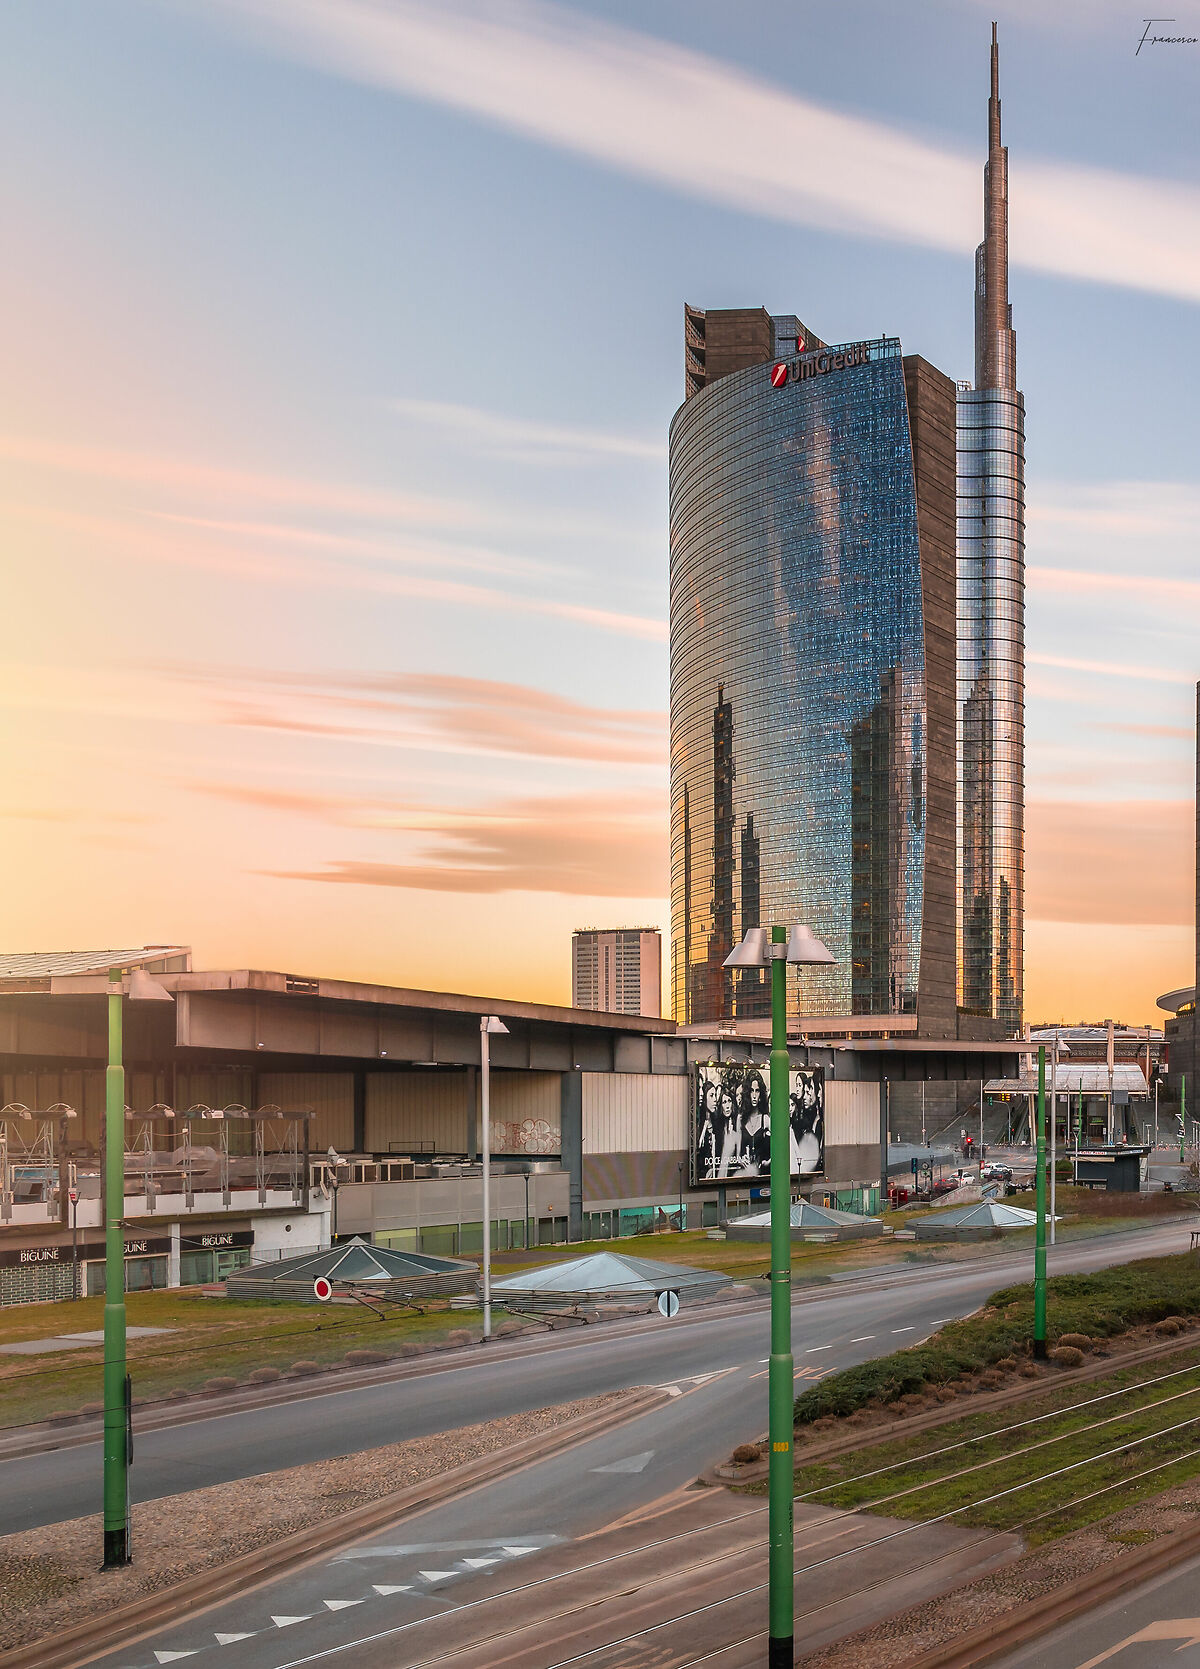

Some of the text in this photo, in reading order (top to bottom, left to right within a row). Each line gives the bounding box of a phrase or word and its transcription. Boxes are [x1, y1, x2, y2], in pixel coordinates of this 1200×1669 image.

[789, 343, 869, 382] UniCredit
[202, 1236, 233, 1246] BIGUINE
[123, 1242, 148, 1254] GUINE
[20, 1249, 59, 1263] BIGUINE
